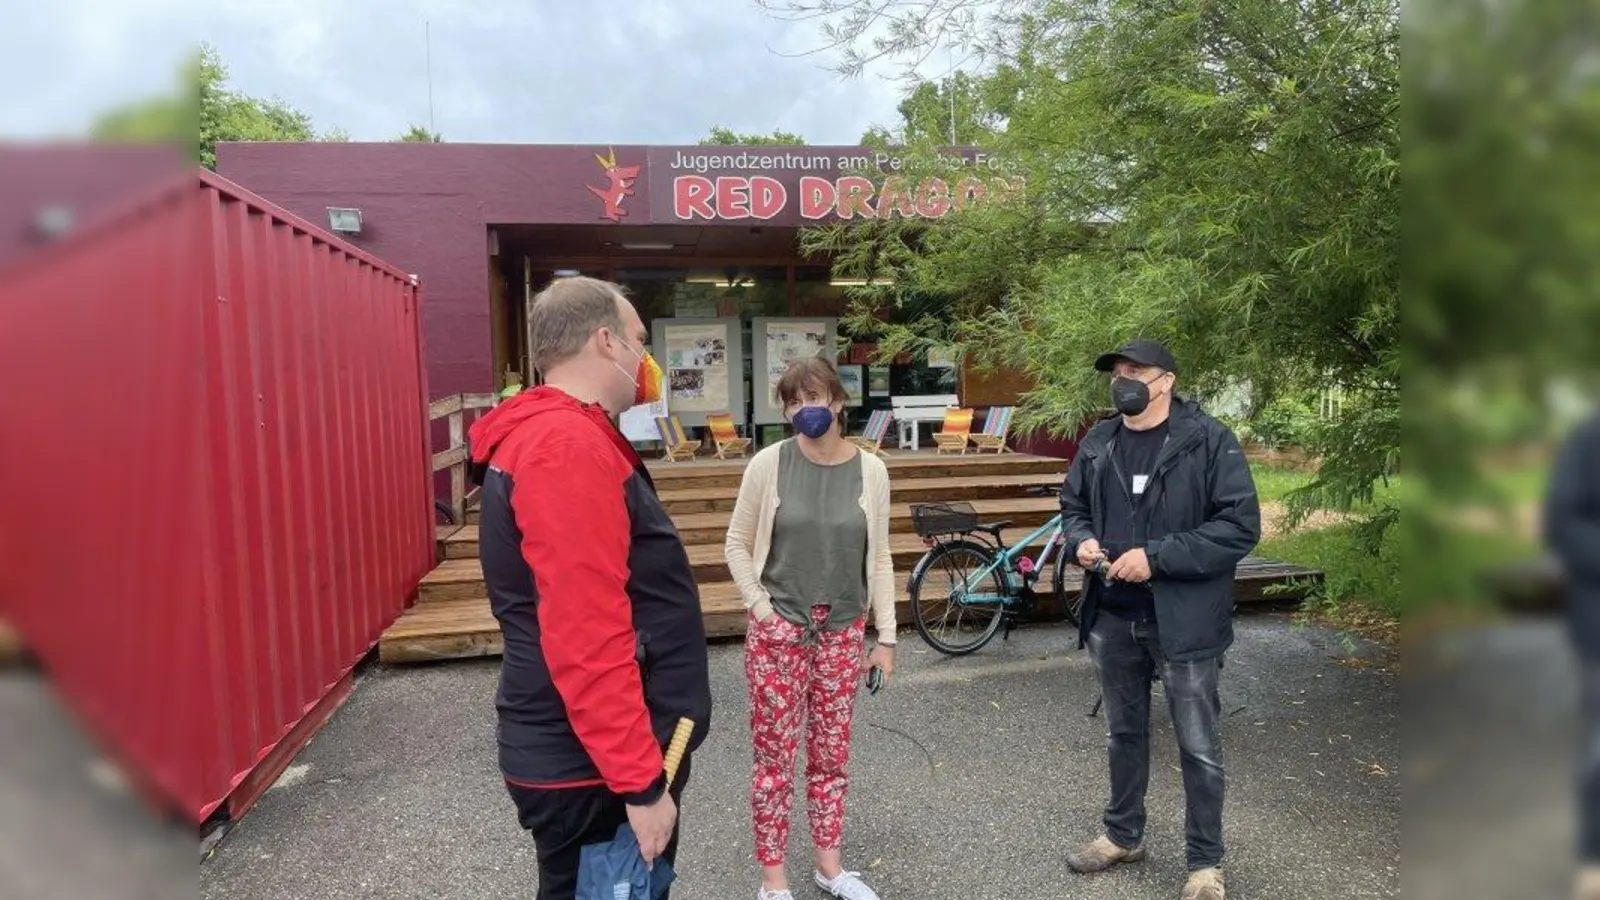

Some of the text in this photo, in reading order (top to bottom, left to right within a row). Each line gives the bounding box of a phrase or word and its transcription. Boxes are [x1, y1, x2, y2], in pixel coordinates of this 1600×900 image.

[671, 151, 831, 173] Jugendzentrum
[837, 156, 869, 171] am
[674, 175, 787, 220] RED
